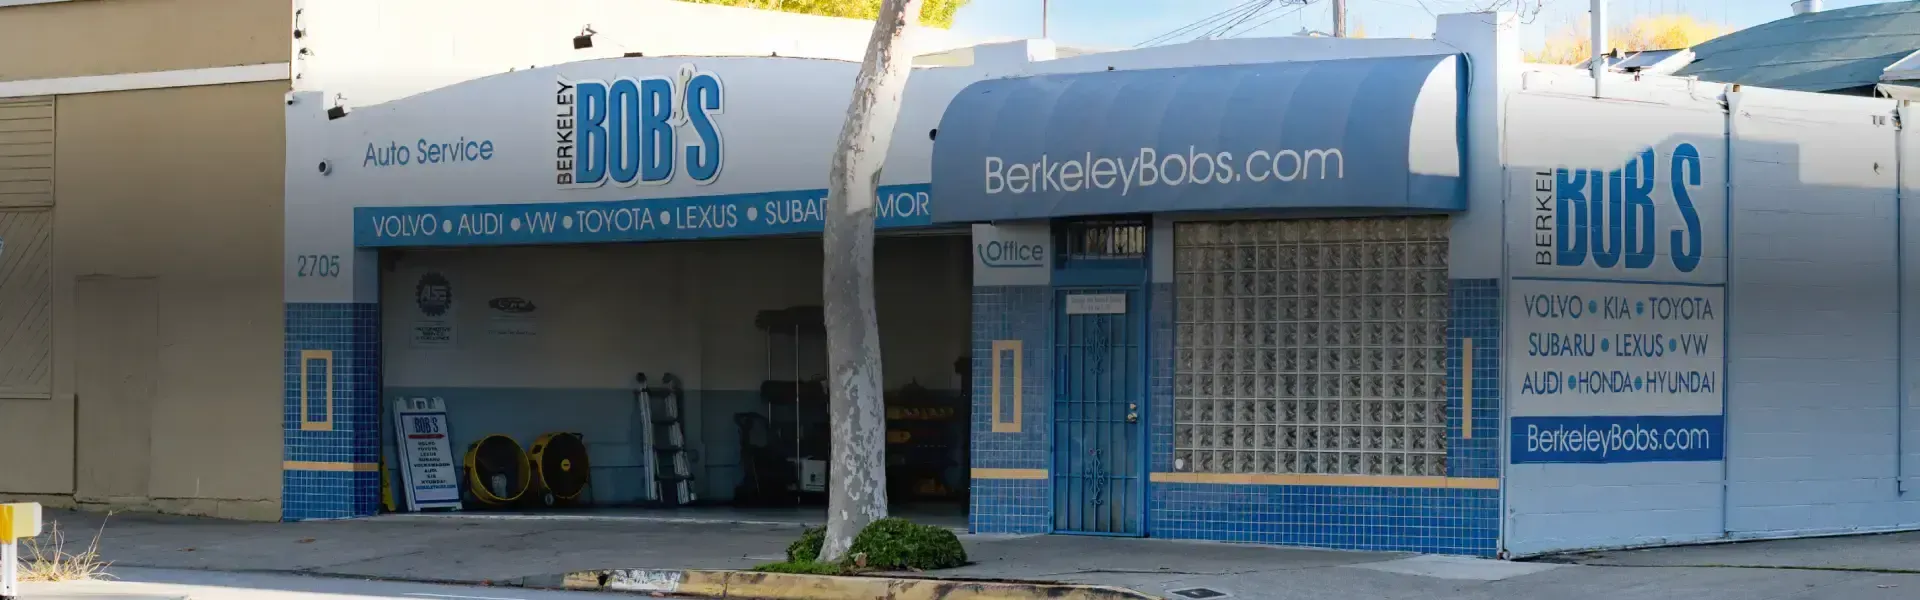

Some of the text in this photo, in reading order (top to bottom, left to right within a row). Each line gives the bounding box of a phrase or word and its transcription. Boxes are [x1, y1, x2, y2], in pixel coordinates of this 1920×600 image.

[557, 80, 574, 185] BERKELEY
[575, 68, 721, 184] BOB'S
[363, 136, 494, 167] Auto Service
[985, 145, 1344, 196] BerkeleyBobs.com
[372, 214, 437, 238] VOLVO
[458, 212, 503, 235] AUDI
[525, 211, 557, 234] VW
[577, 207, 656, 233] TOYOTA
[677, 203, 738, 230] LEXUS
[875, 191, 930, 218] MOR
[1535, 168, 1552, 266] BERKEL
[298, 254, 340, 278] 2705
[986, 240, 1044, 262] Office
[1524, 294, 1714, 320] VOLVO KIA TOYOTA
[1528, 332, 1709, 357] SUBARU LEXUS VW
[1521, 370, 1715, 395] AUDI HONDA HYUNDAI
[1528, 423, 1710, 458] BerkeleyBobs.com
